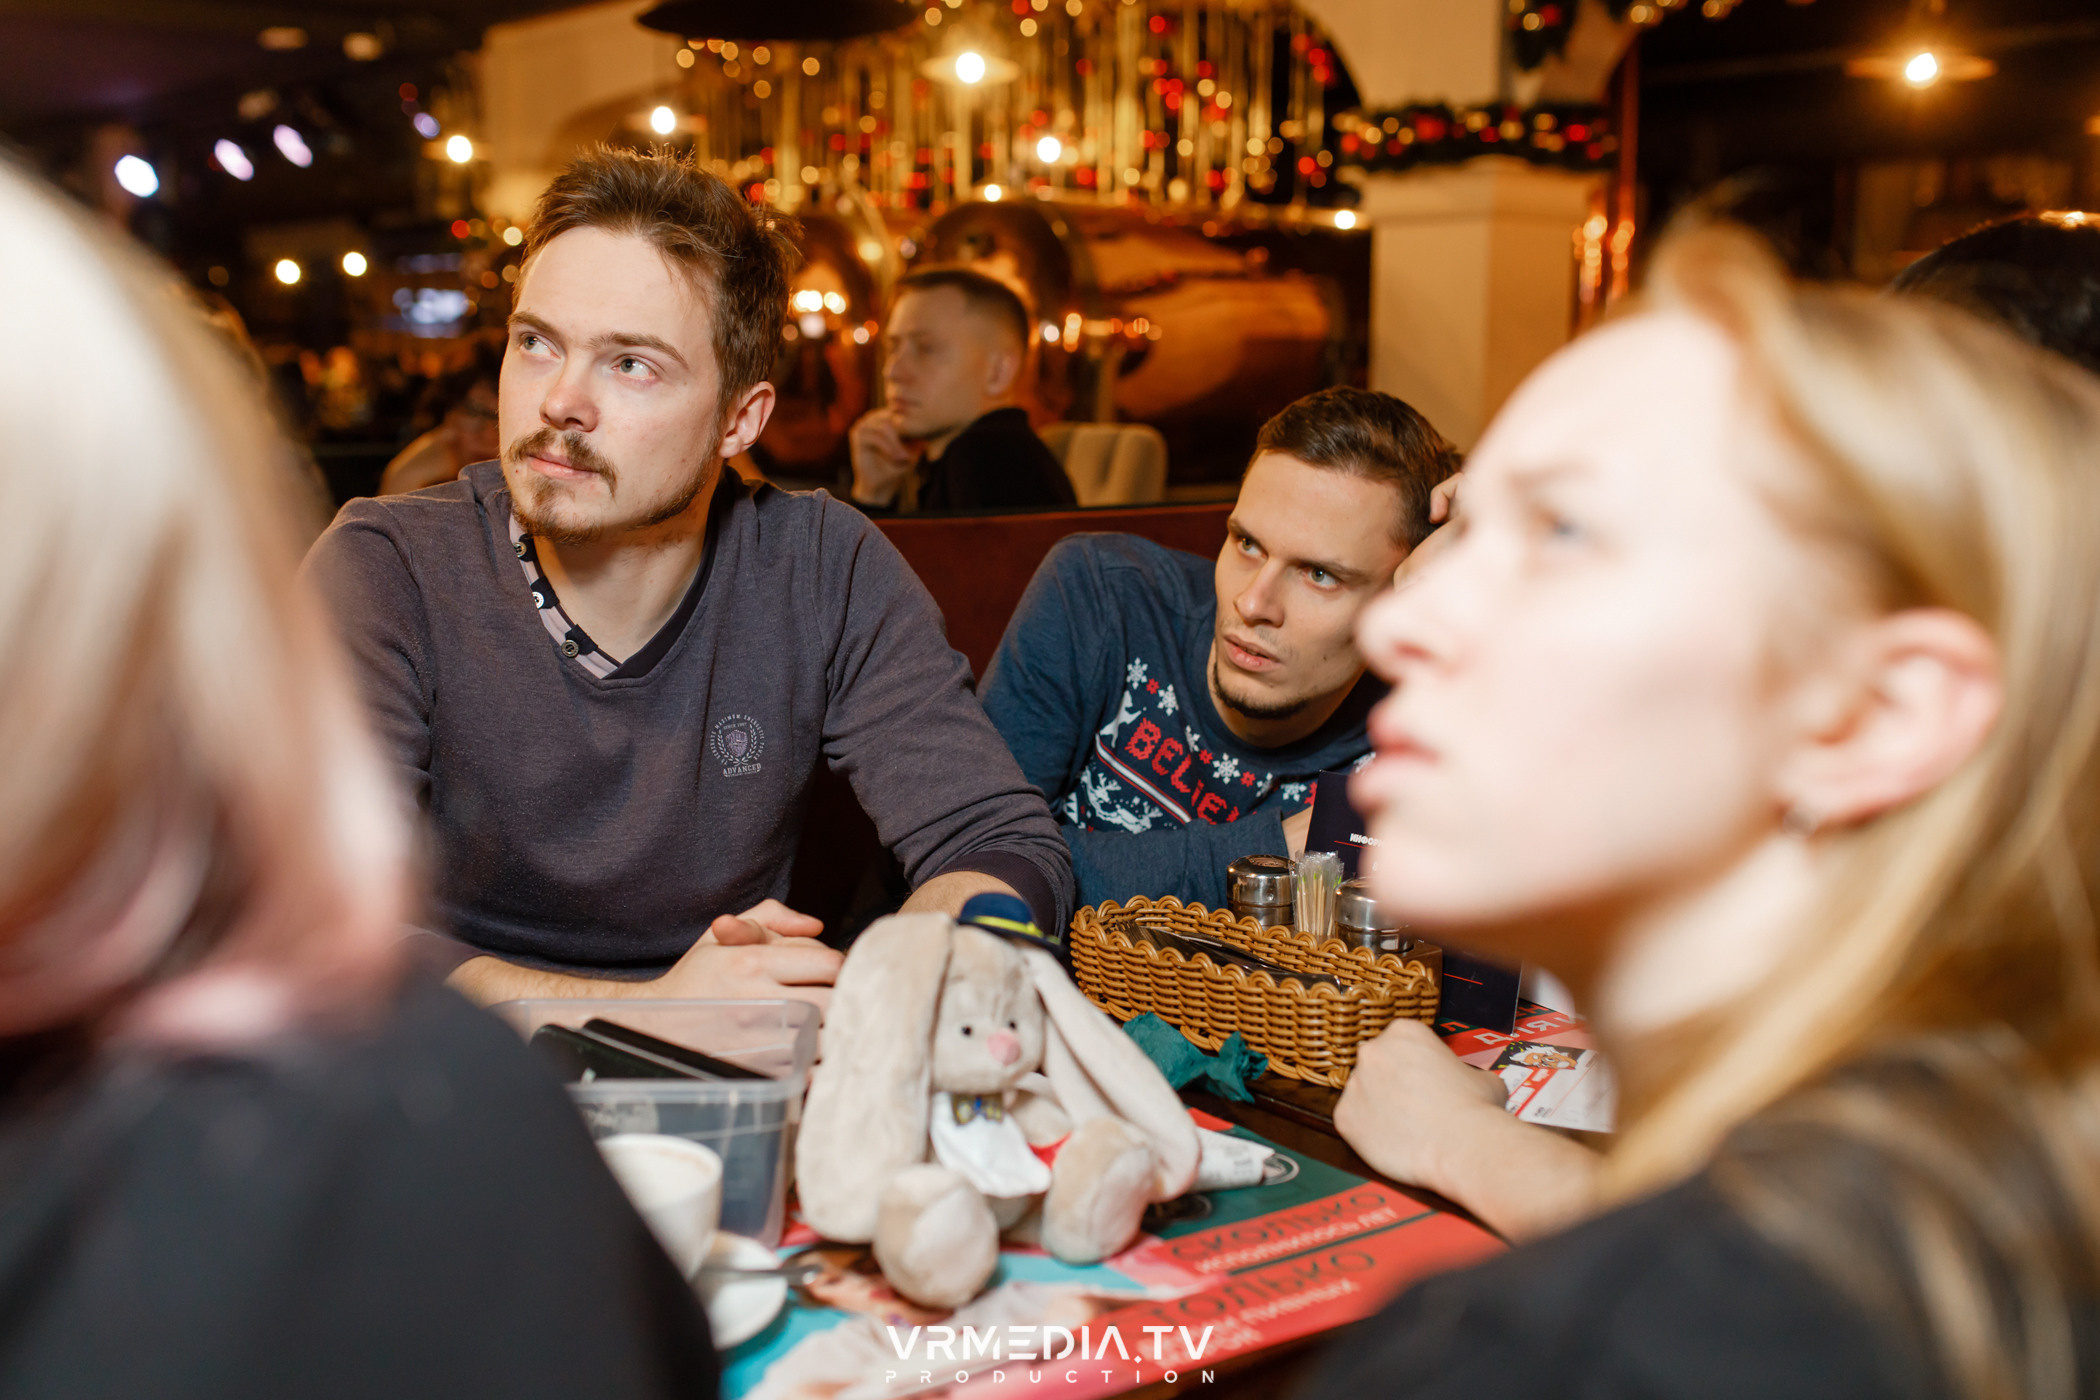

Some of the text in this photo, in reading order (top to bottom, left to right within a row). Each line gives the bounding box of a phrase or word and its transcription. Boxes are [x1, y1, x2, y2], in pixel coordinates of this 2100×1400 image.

[722, 763, 762, 776] ADVANCED
[1349, 833, 1384, 848] ИНФОР
[1172, 1192, 1386, 1262] СКОЛЬКО
